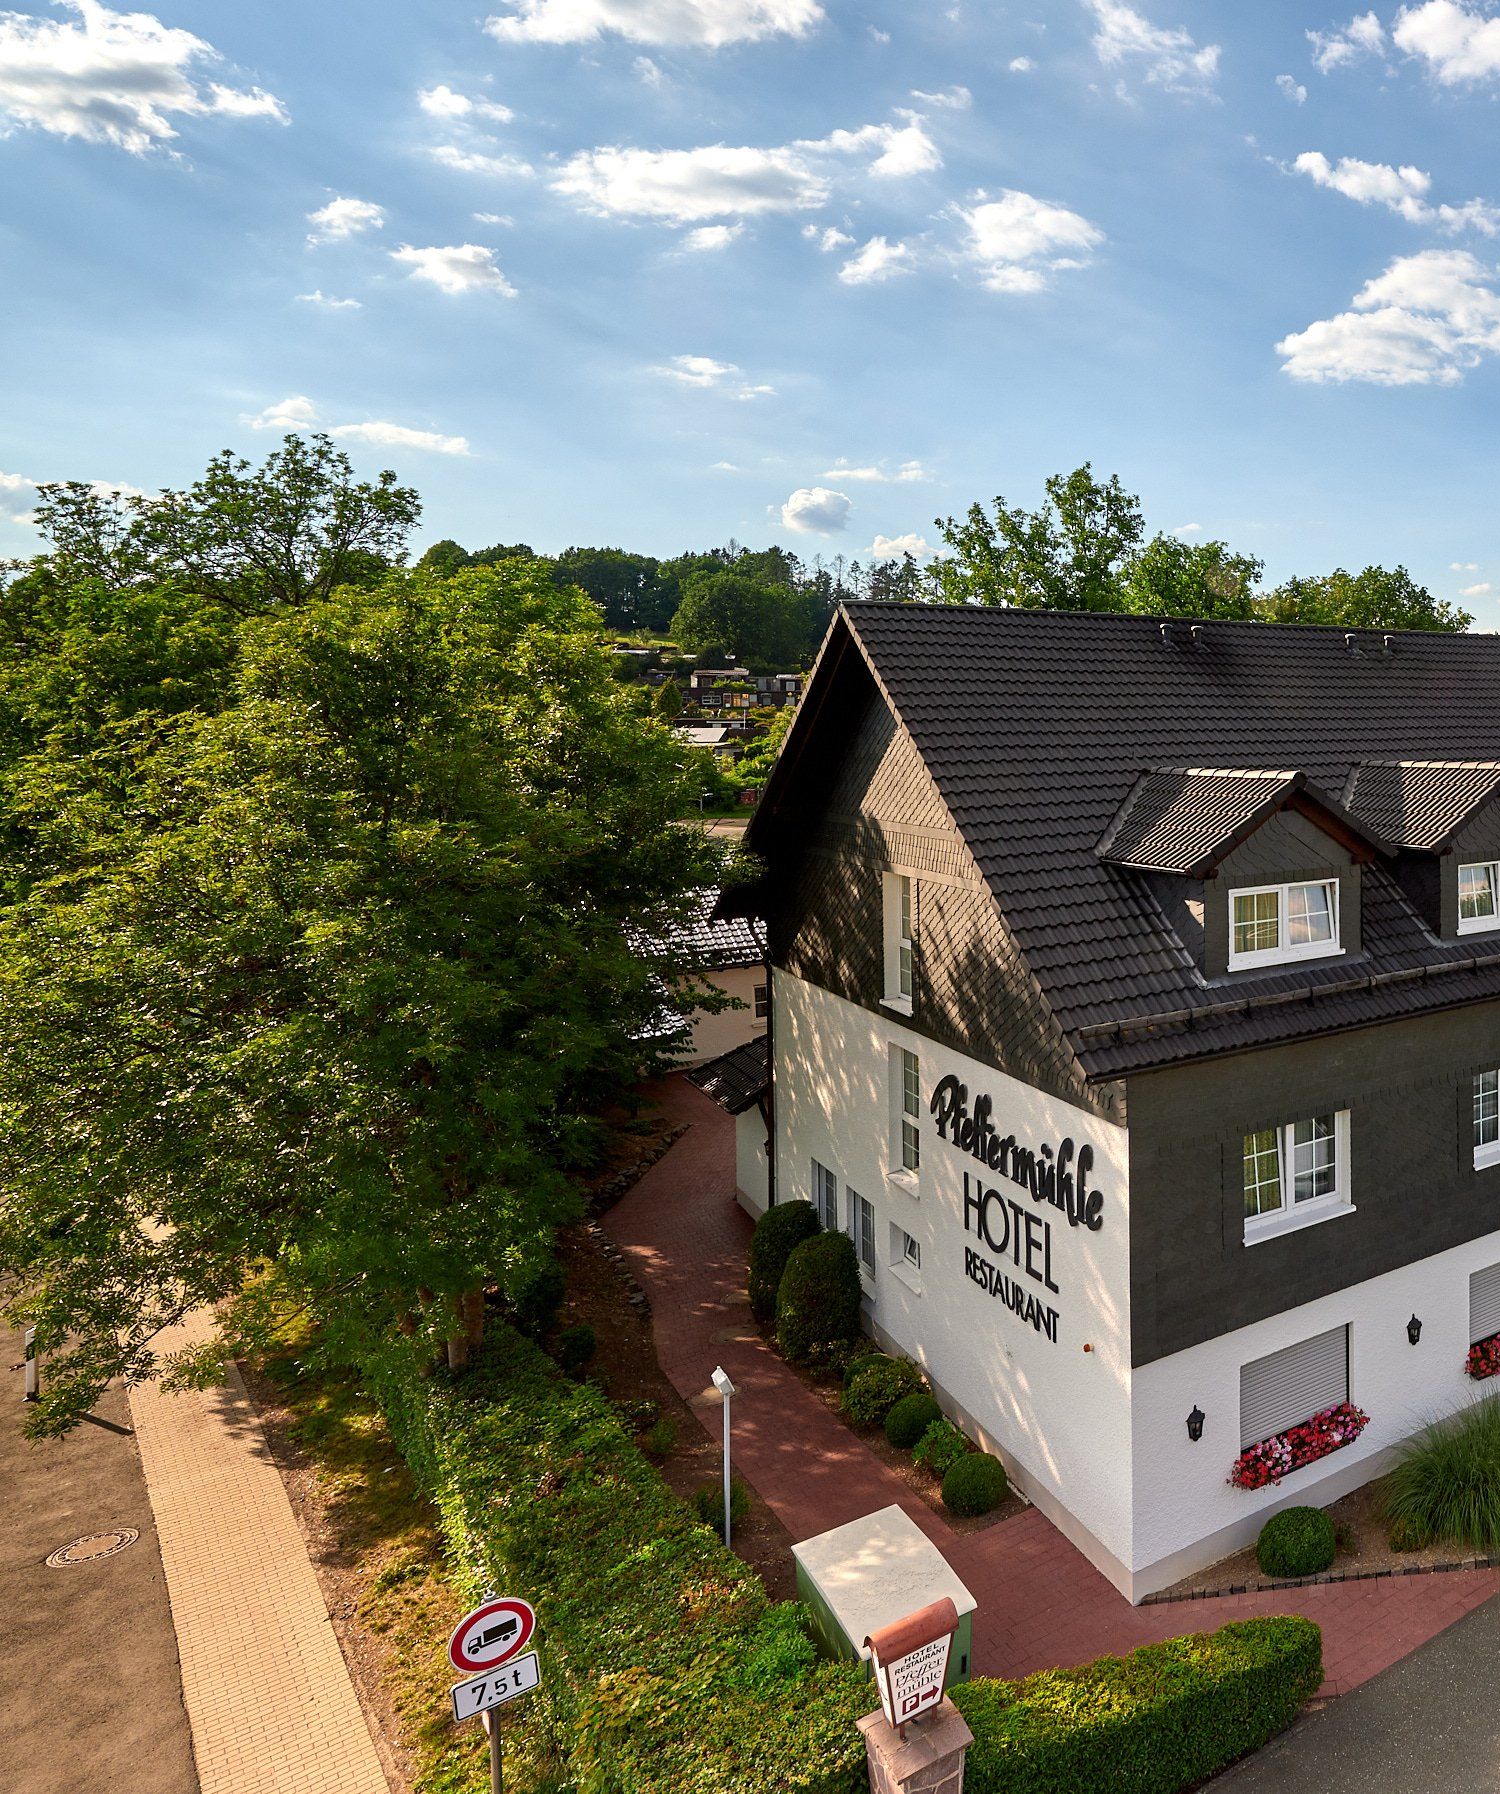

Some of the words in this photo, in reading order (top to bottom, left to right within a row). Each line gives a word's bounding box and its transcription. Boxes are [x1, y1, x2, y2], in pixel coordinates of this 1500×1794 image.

[930, 1074, 1104, 1231] Pfeffermühle
[963, 1171, 1059, 1294] HOTEL
[964, 1246, 1060, 1343] RESTAURANT
[512, 1669, 523, 1687] t
[894, 1645, 946, 1676] RESTAURANT
[904, 1643, 939, 1664] HOTEL
